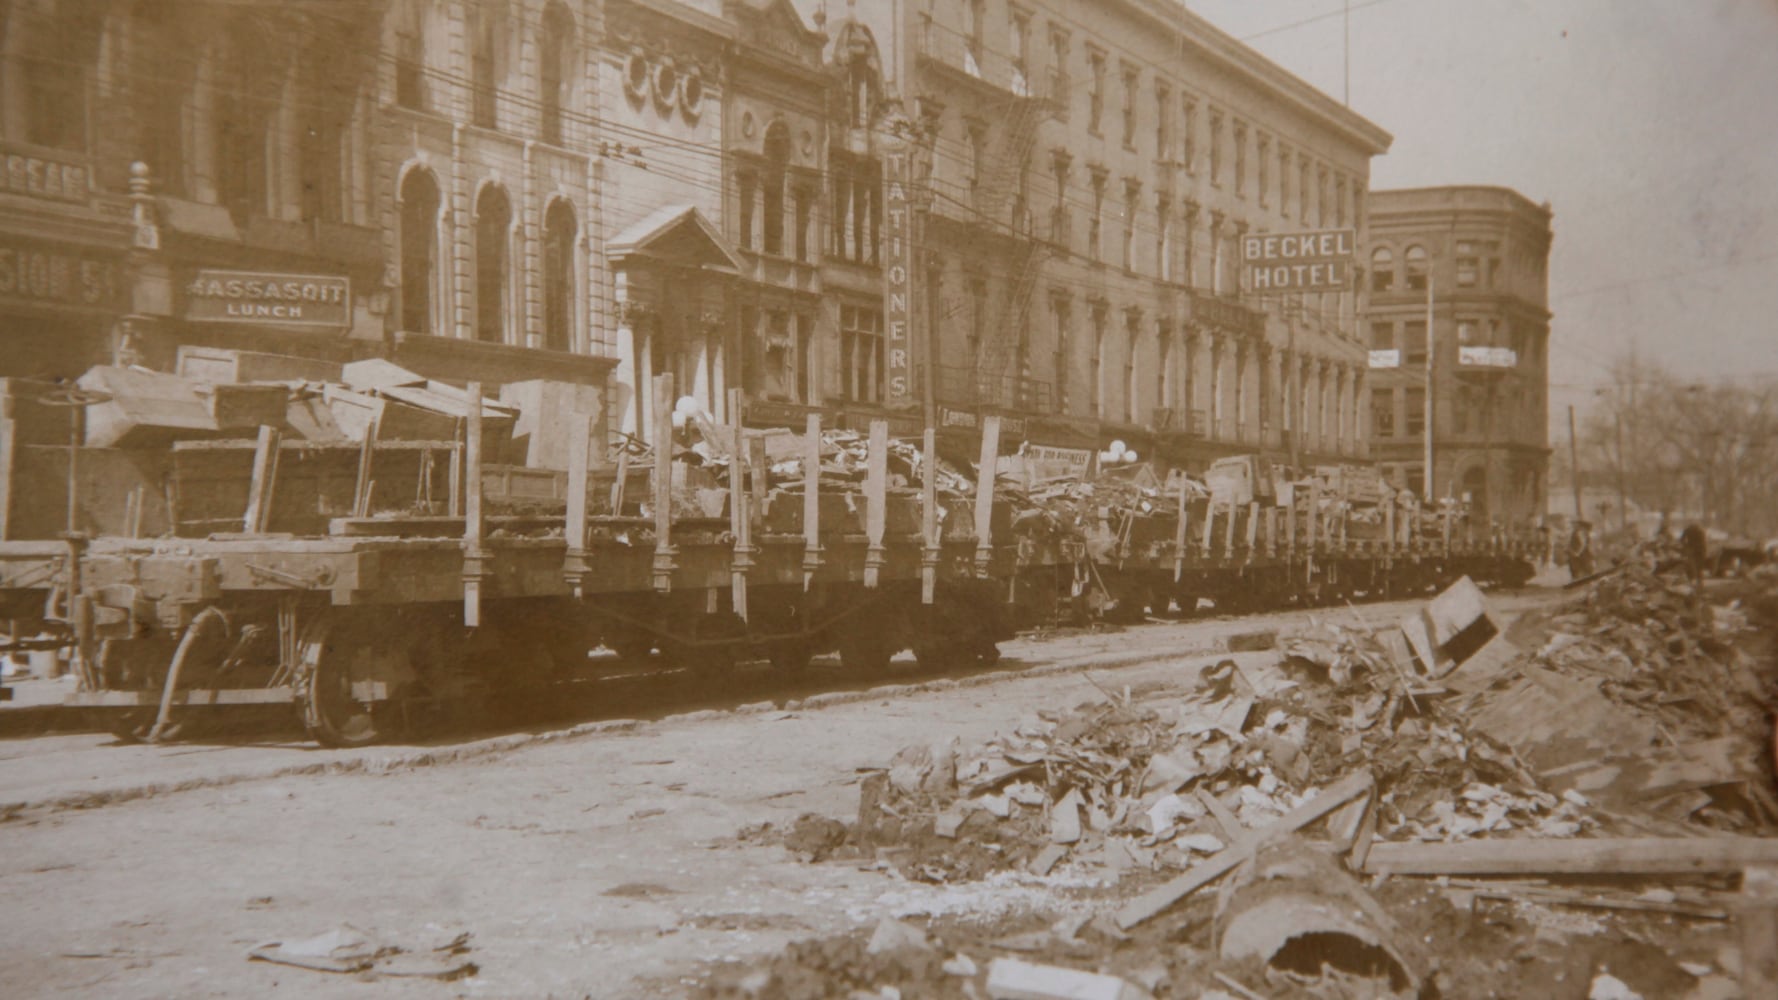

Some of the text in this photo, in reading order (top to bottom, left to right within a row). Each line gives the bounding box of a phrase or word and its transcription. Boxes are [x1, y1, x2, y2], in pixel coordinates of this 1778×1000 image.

[1245, 233, 1351, 260] BECKEL
[887, 153, 907, 398] TATIONERS
[1254, 263, 1343, 289] HOTEL
[227, 303, 303, 318] LUNCH
